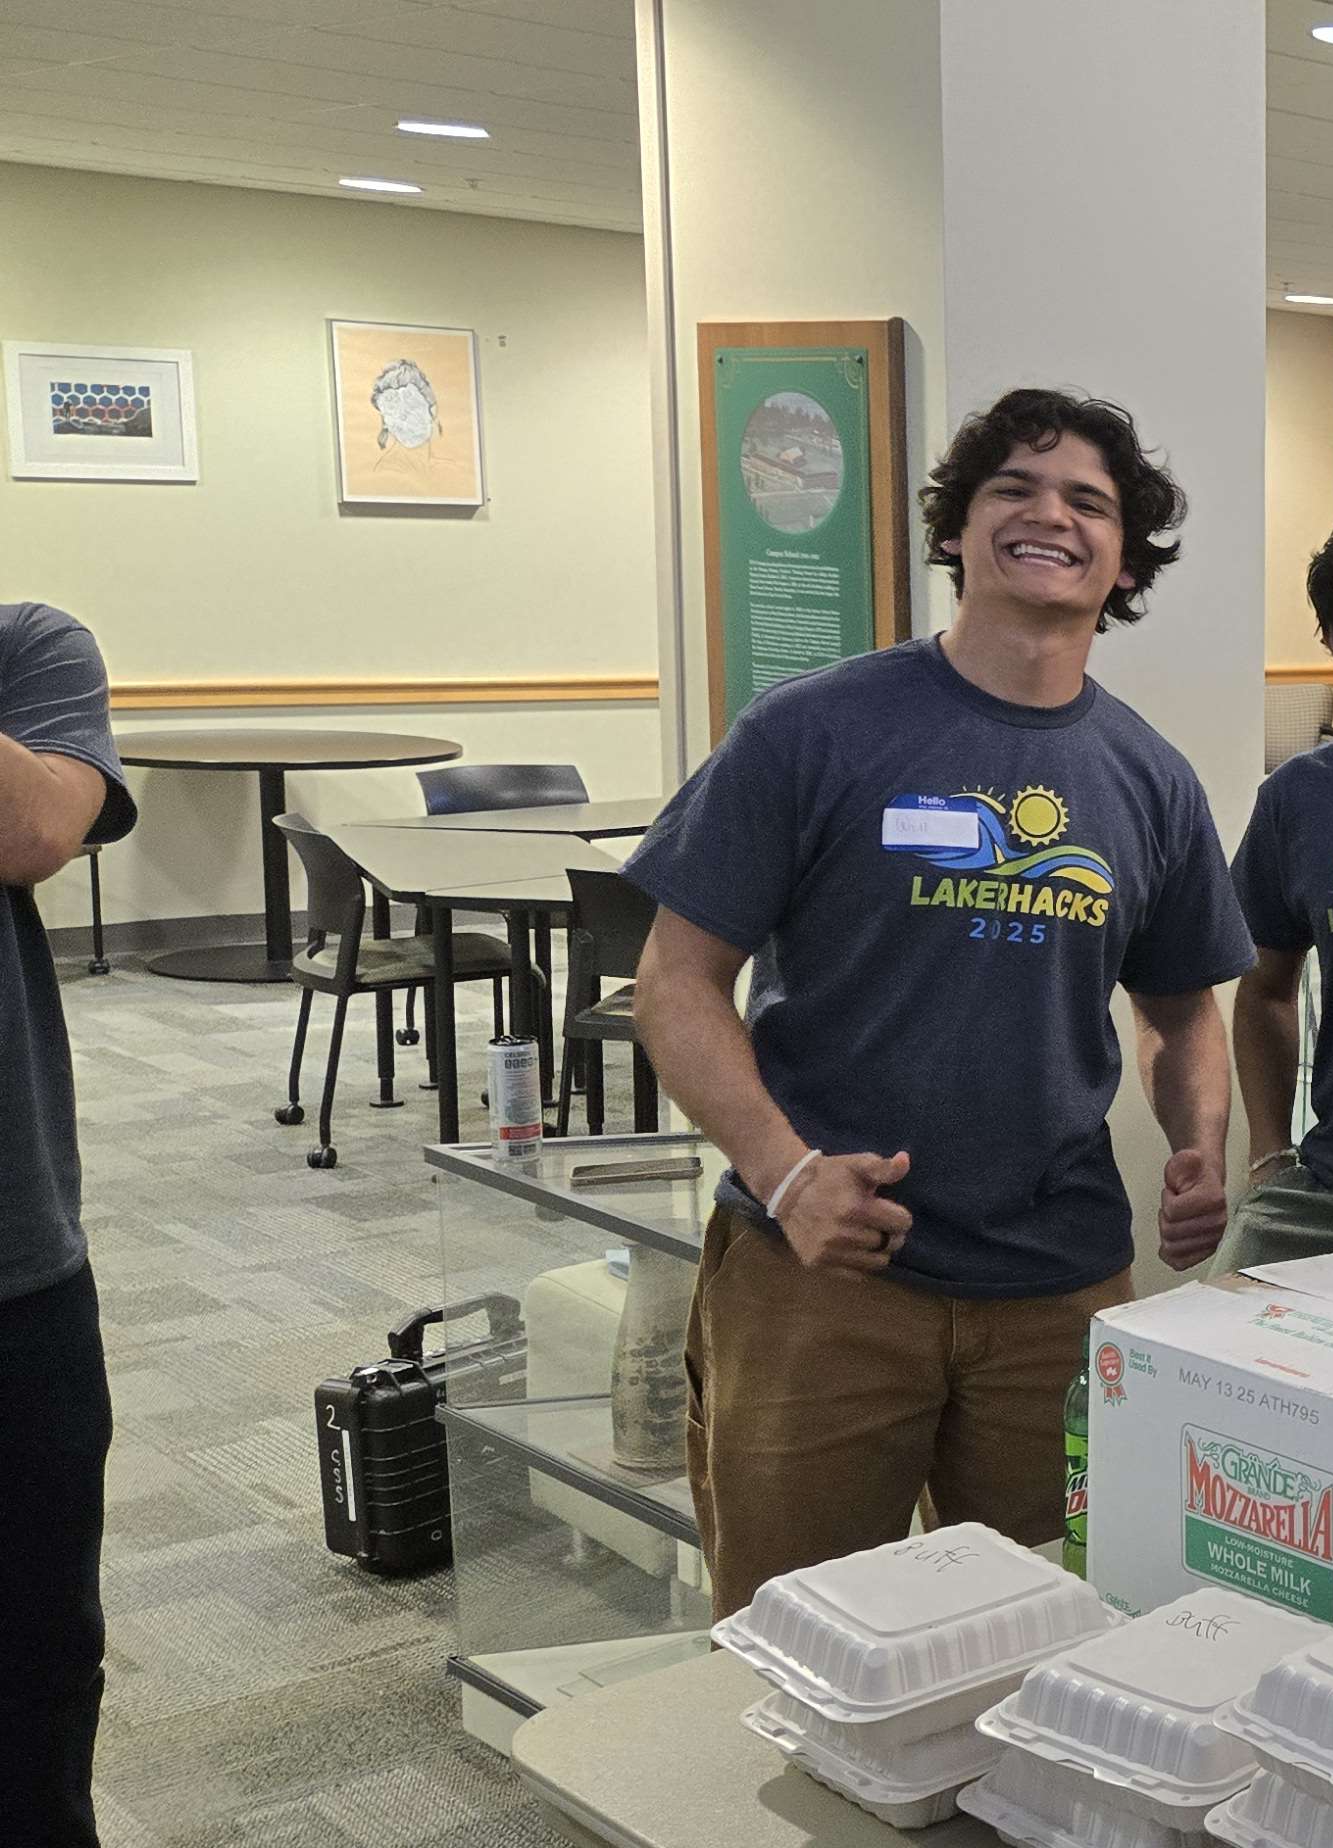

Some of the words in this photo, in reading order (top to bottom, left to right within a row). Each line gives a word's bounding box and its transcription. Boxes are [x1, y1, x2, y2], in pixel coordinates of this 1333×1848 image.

[918, 795, 946, 806] Hello
[910, 875, 1110, 927] LAKERHACKS
[325, 1404, 341, 1430] 2
[1179, 1368, 1210, 1392] MAY
[1216, 1380, 1233, 1398] 13
[1237, 1386, 1256, 1405] 25
[1259, 1396, 1320, 1425] ATH795
[1221, 1448, 1296, 1500] GRANDE
[1208, 1541, 1267, 1579] WHOLE
[1271, 1566, 1312, 1596] MILK
[1225, 1536, 1294, 1568] LOW-MOISTURE
[1210, 1563, 1270, 1593] MOZZARELLA
[1272, 1586, 1309, 1608] CHEESE
